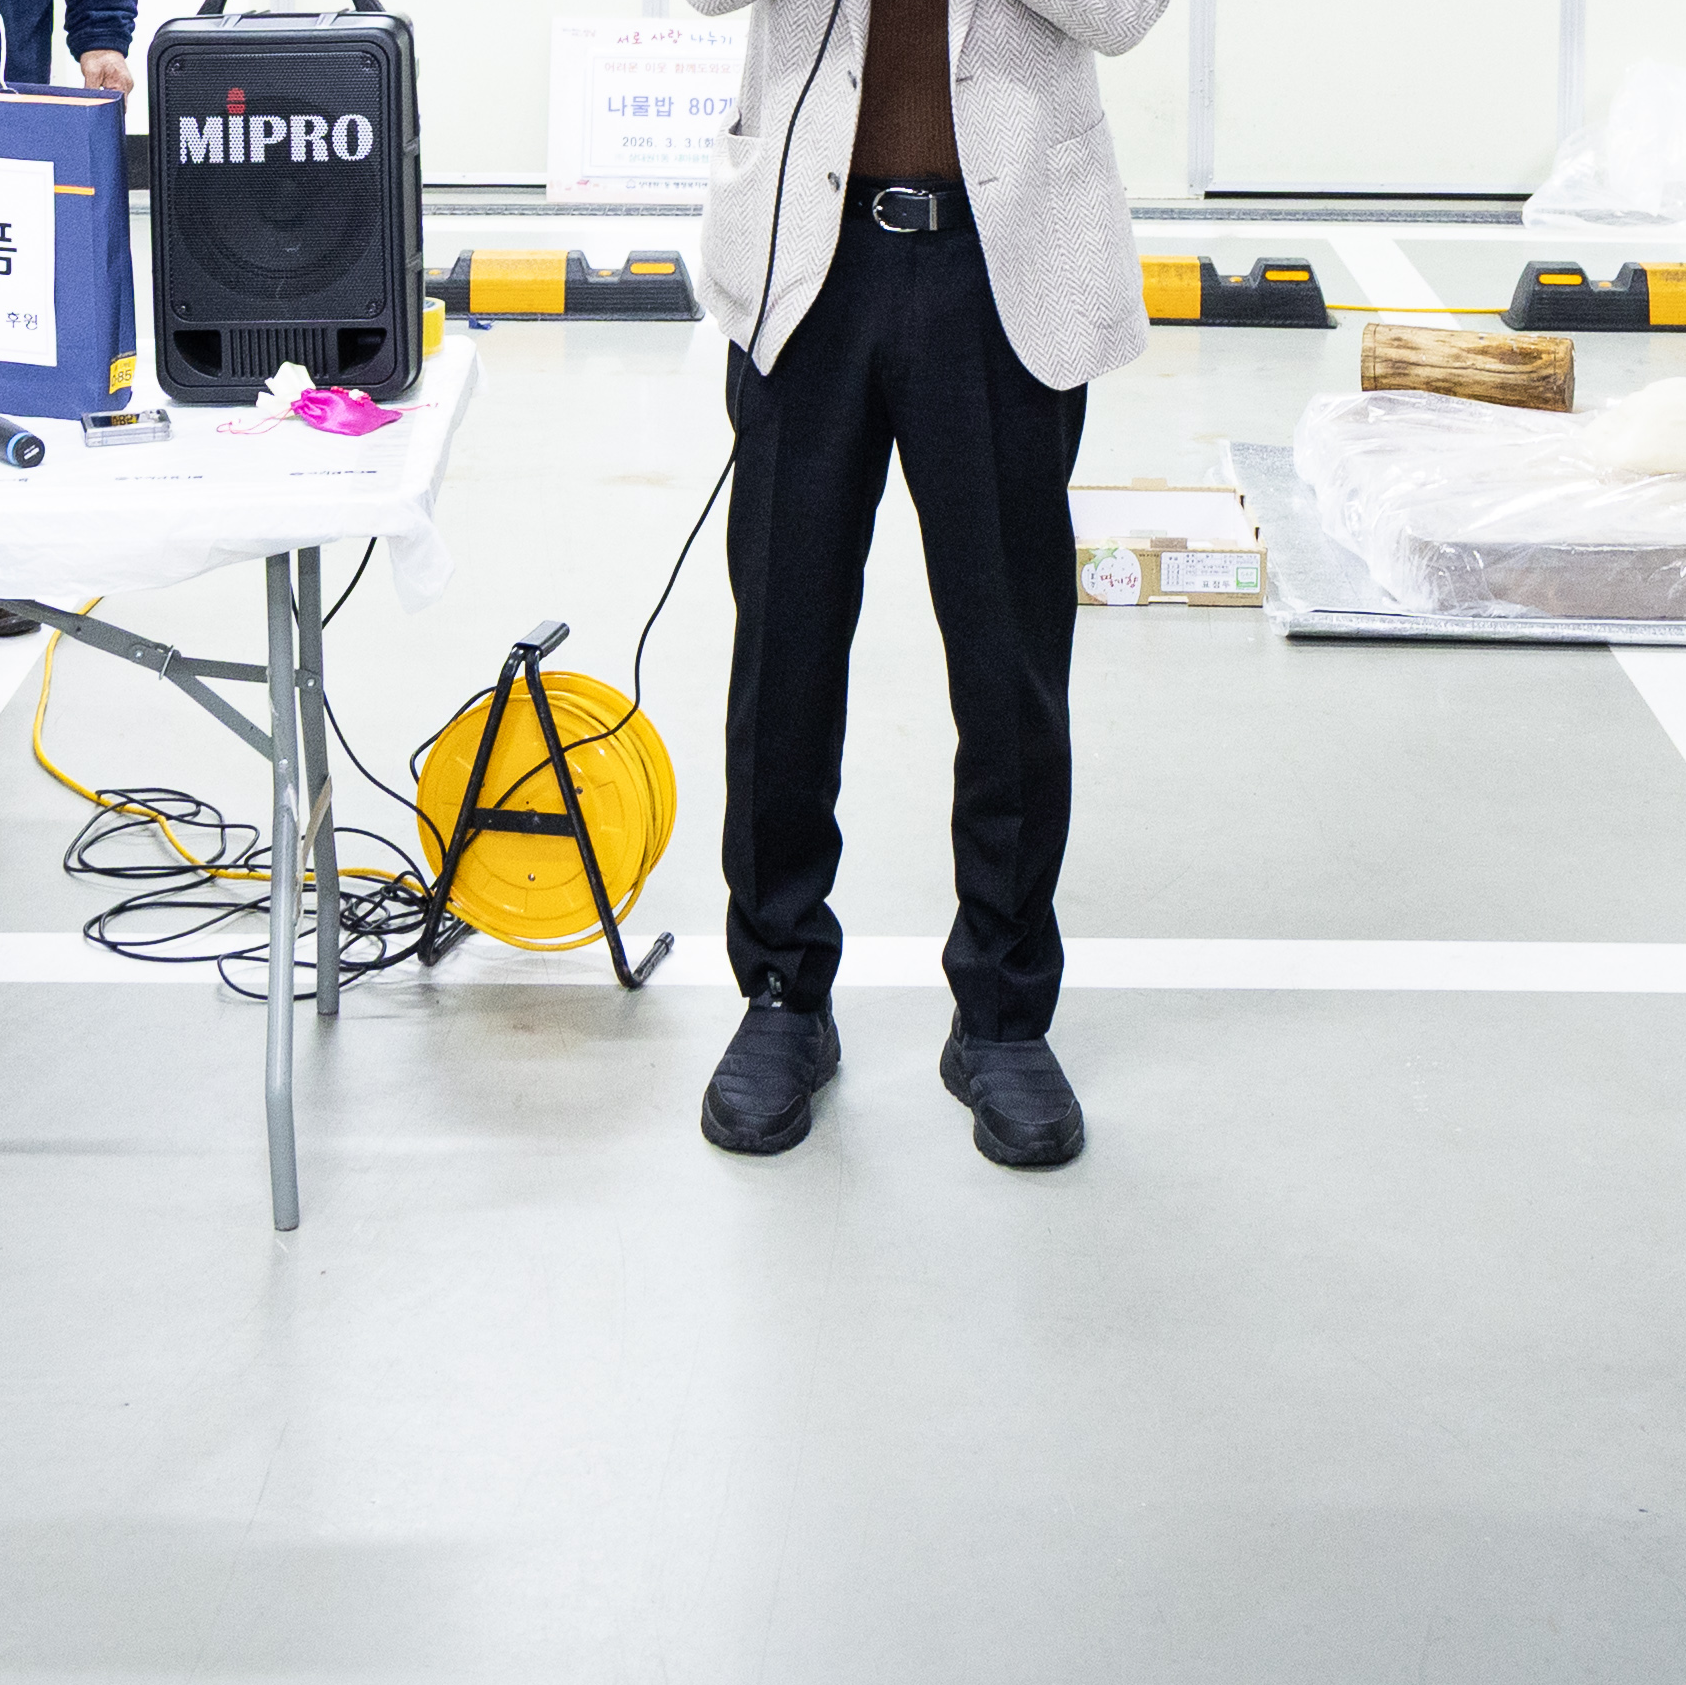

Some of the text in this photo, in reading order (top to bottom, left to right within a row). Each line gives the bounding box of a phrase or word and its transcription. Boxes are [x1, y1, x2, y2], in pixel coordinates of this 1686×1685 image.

[616, 30, 643, 46] 서로
[650, 28, 683, 45] 사랑
[690, 30, 733, 46] 나누기
[607, 94, 675, 118] 나물밥
[179, 88, 375, 165] MIPRO
[6, 310, 39, 331] 후원
